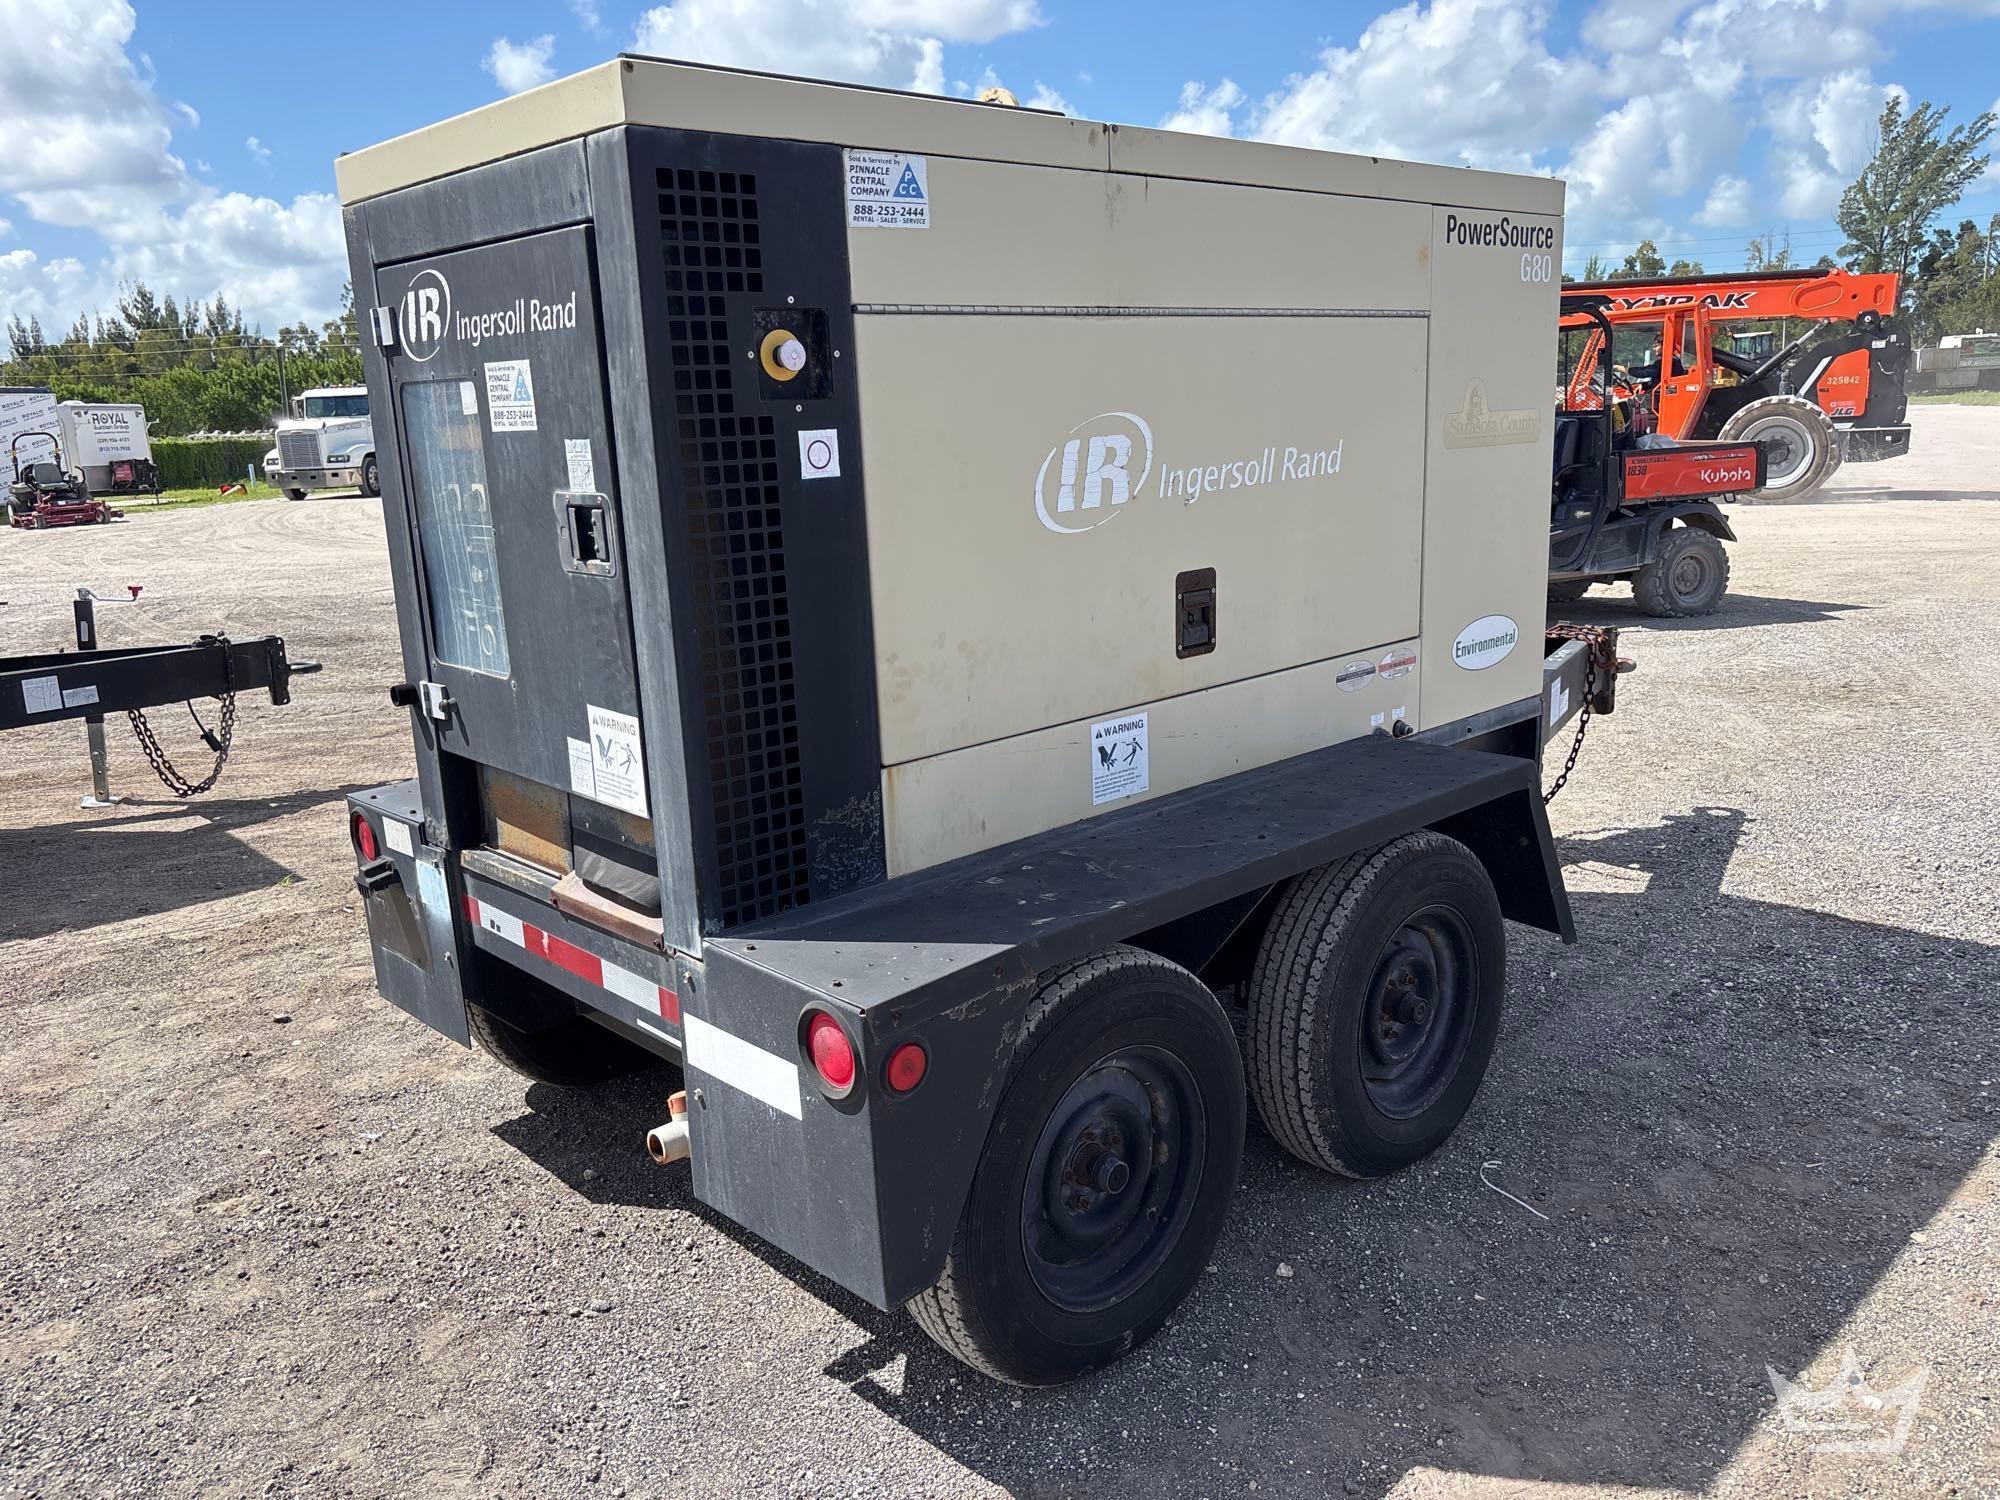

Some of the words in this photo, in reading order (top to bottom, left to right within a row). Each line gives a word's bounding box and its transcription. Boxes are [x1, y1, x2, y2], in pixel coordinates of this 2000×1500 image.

[848, 155, 861, 163] Sold
[868, 157, 893, 165] Serviced
[849, 165, 890, 176] PINNACLE
[850, 176, 886, 186] CENTRAL
[850, 186, 890, 197] COMPANY
[854, 204, 924, 217] 888-253-2444
[852, 215, 875, 223] RENTAL
[880, 216, 898, 224] SALES
[902, 217, 926, 225] SERVICE
[1446, 214, 1554, 249] PowerSource
[1520, 253, 1552, 283] G80
[456, 298, 525, 347] Ingersoll
[530, 290, 576, 332] Rand
[1826, 375, 1861, 385] 325842
[490, 393, 513, 403] COMPANY
[493, 410, 533, 420] 888-253-2444
[1830, 407, 1856, 416] JLG
[91, 412, 129, 425] ROYAL
[1159, 447, 1276, 506] Ingersoll
[1281, 438, 1344, 481] Rand
[1627, 465, 1648, 476] 1838
[1700, 466, 1751, 483] Kubota
[1455, 628, 1516, 659] Environmental
[599, 715, 636, 736] WARNING
[1103, 719, 1144, 737] WARNING
